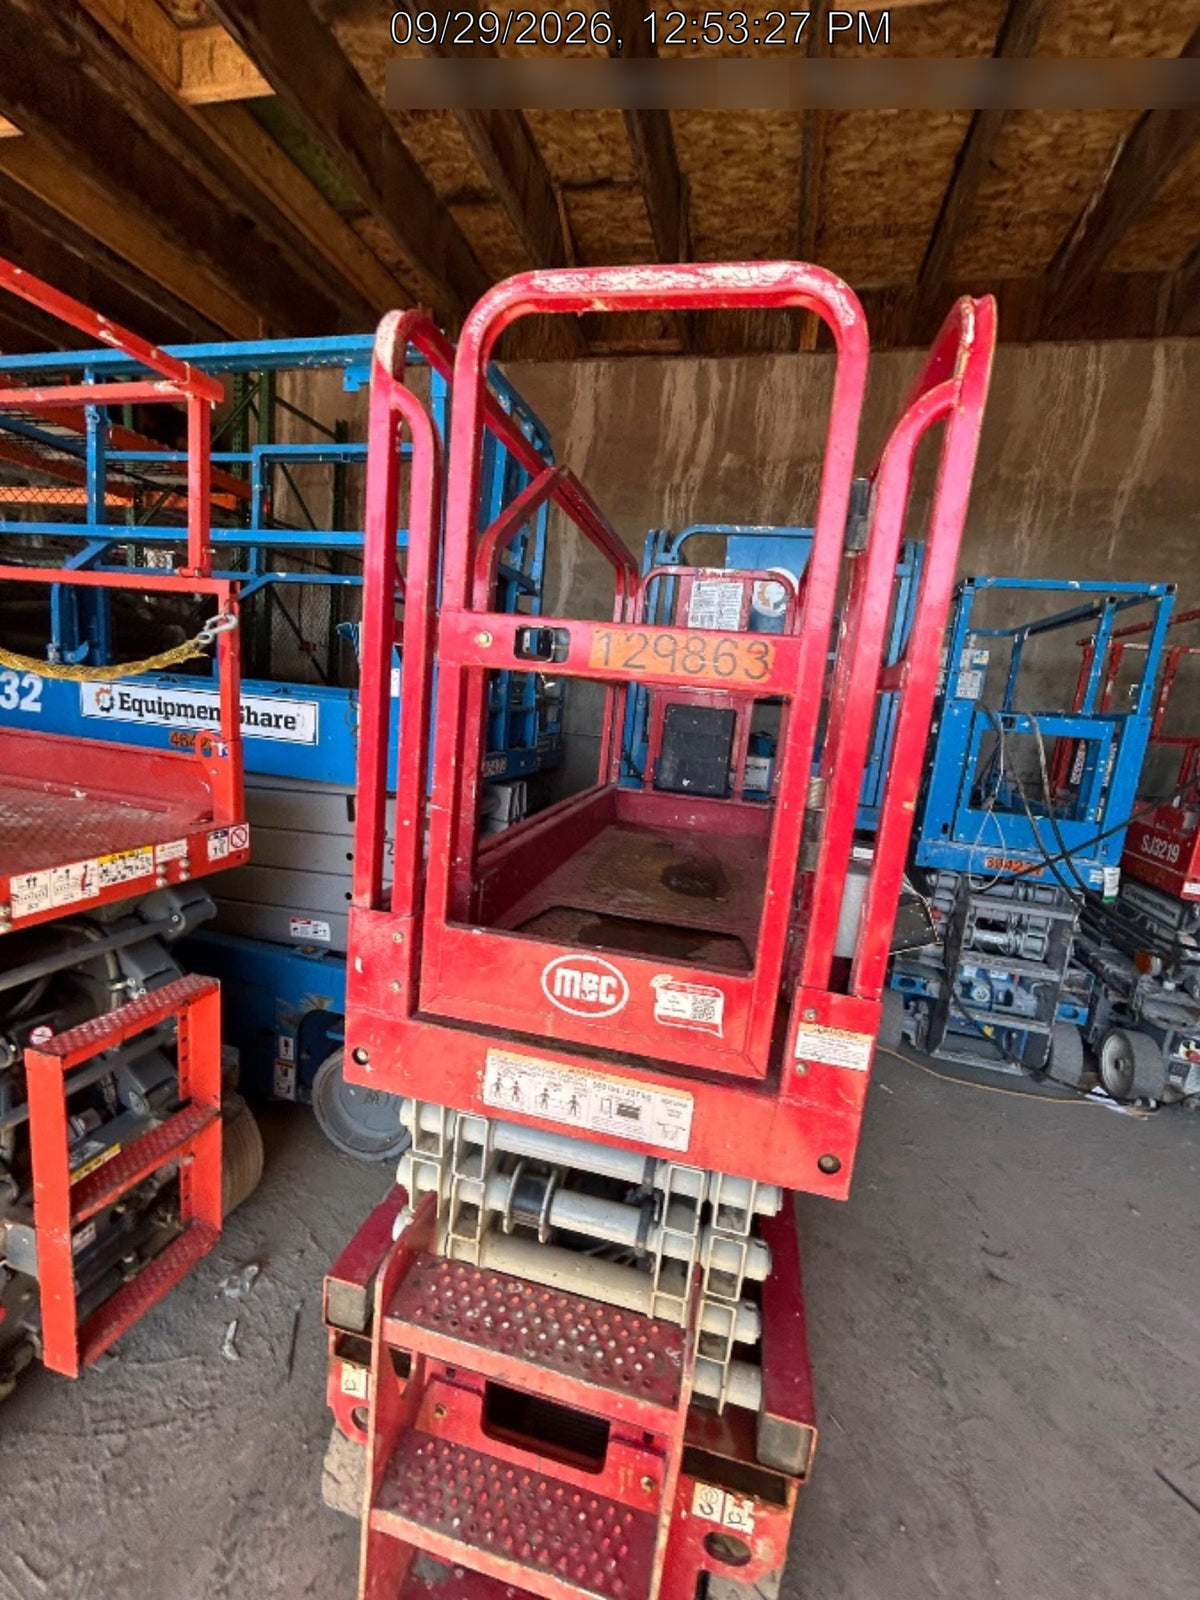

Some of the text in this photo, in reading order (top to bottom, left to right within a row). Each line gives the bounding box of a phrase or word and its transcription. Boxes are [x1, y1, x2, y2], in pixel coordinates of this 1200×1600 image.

[597, 632, 769, 680] 129863
[0, 671, 43, 712] 32
[1141, 834, 1180, 864] SJ3219
